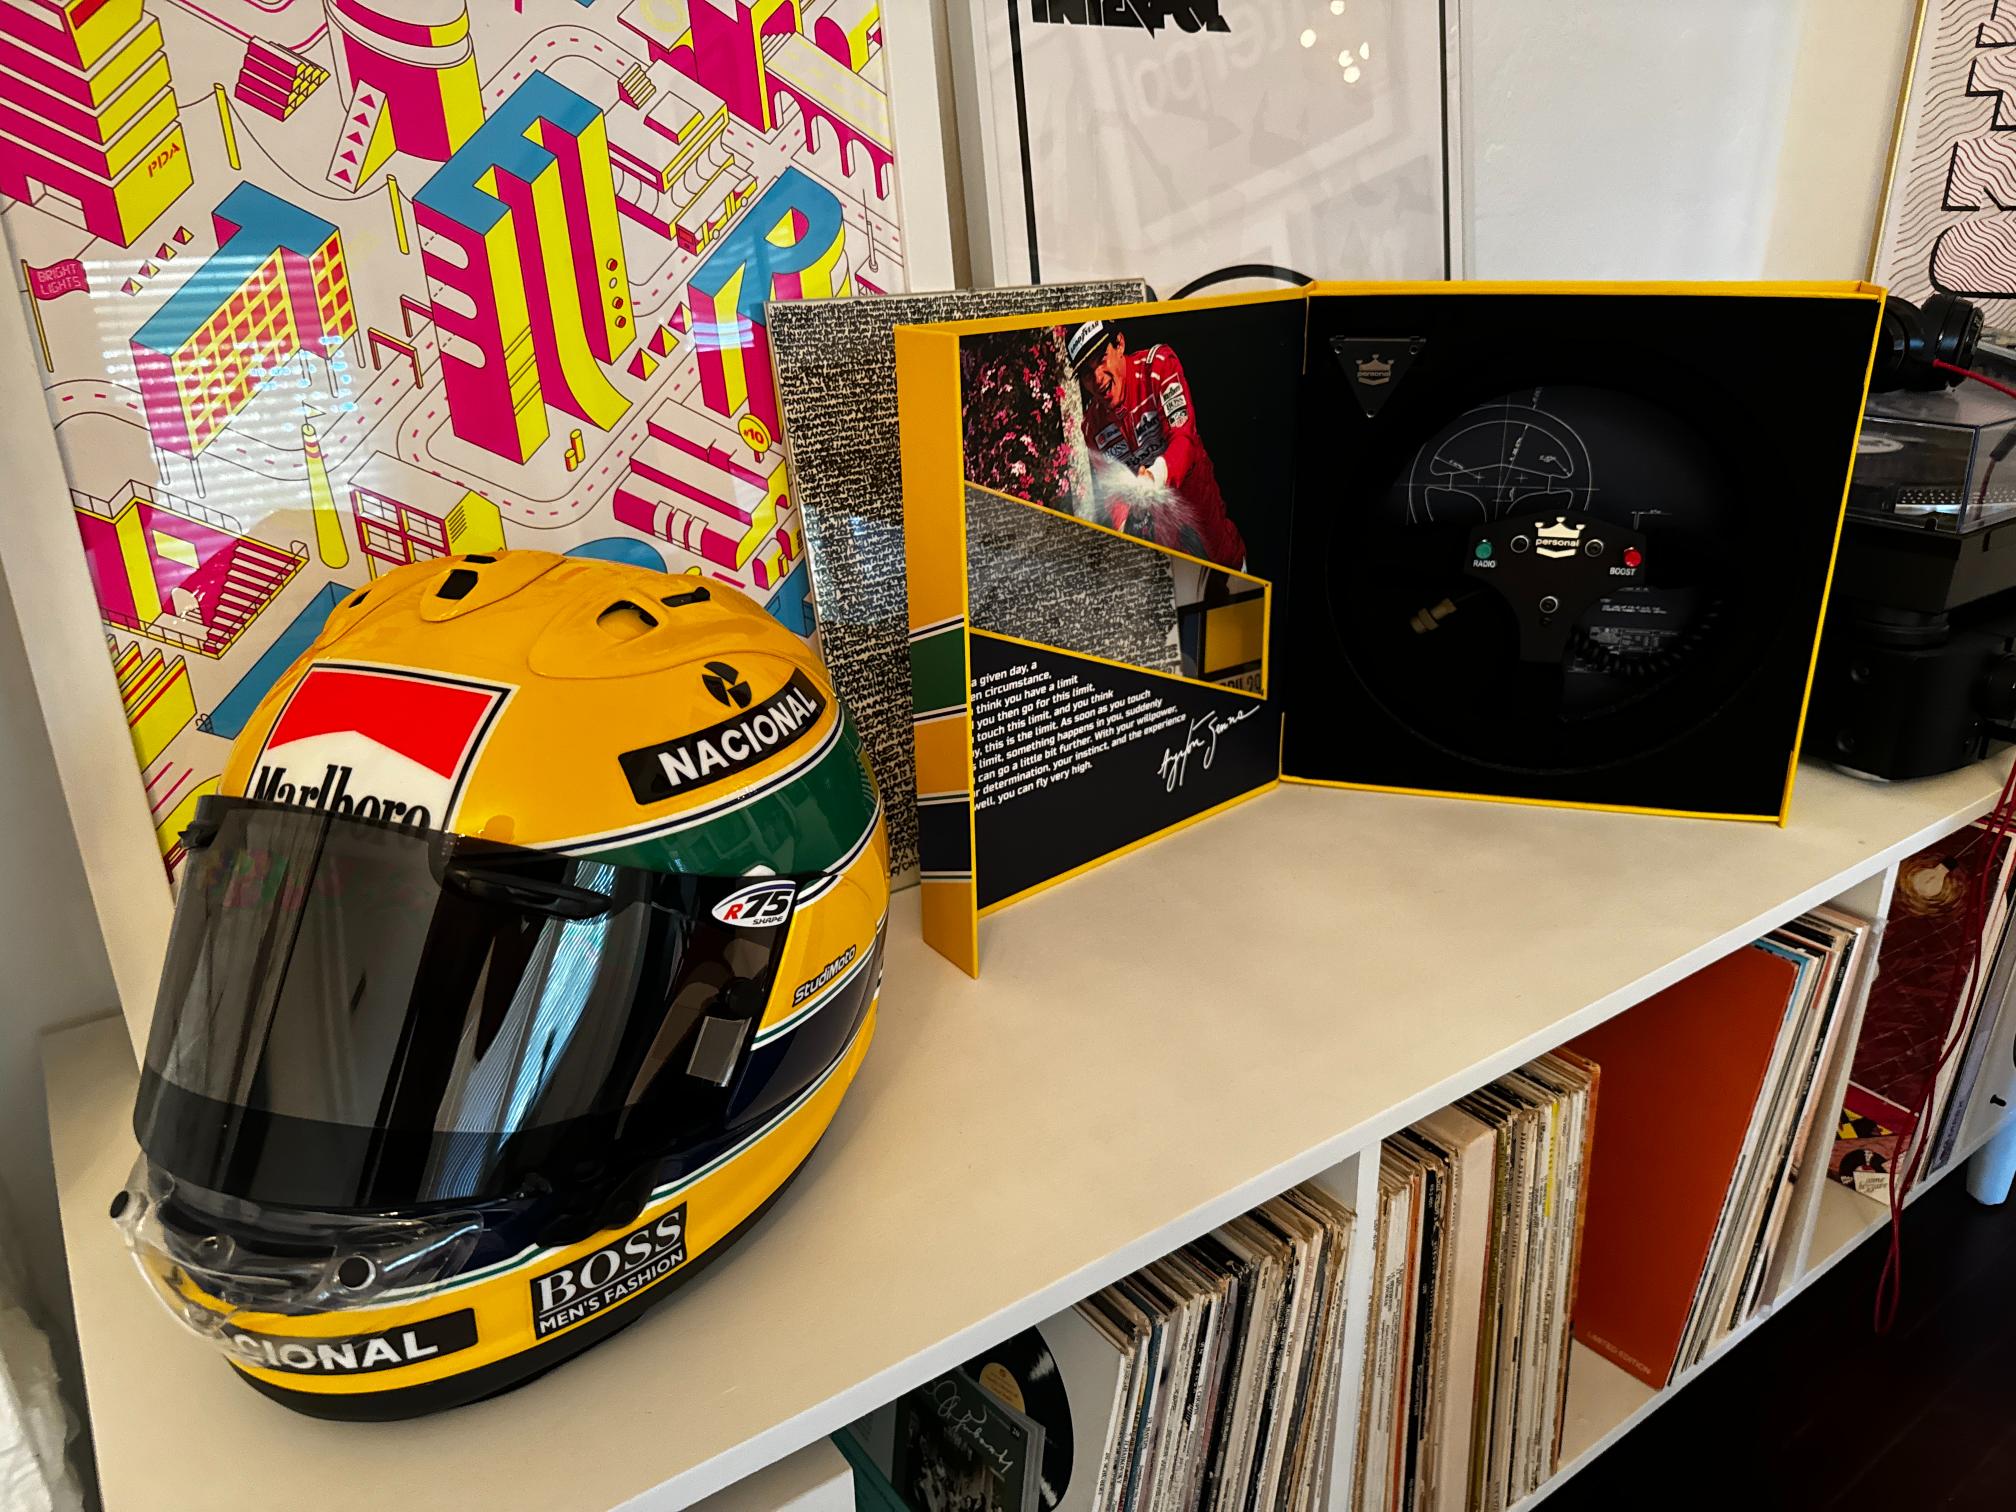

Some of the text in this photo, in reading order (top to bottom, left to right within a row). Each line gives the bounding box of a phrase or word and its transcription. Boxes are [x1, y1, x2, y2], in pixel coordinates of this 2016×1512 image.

[148, 142, 181, 178] PDA
[37, 264, 76, 283] BRIGHT
[40, 277, 81, 294] LIGHTS
[1536, 538, 1580, 548] personal
[1473, 559, 1496, 569] RADIO
[1609, 566, 1636, 577] BOOST
[980, 670, 1007, 687] given
[1031, 661, 1038, 670] a
[976, 675, 1078, 715] think you have a limit
[976, 716, 995, 730] you
[997, 708, 1020, 722] then
[1021, 703, 1034, 716] go
[1035, 697, 1051, 709] for
[1052, 691, 1070, 704] this
[977, 726, 1005, 742] touch
[1007, 720, 1026, 732] this
[1053, 704, 1071, 717] and
[1072, 699, 1089, 712] you
[1091, 689, 1114, 704] think
[984, 740, 1004, 753] this
[1006, 736, 1015, 746] is
[1017, 729, 1033, 740] the
[1060, 717, 1073, 728] As
[1074, 709, 1096, 723] soon
[1097, 704, 1108, 715] as
[1109, 699, 1126, 712] you
[1127, 689, 1151, 705] touch
[1006, 736, 1055, 759] something
[1057, 722, 1095, 742] happens
[1096, 717, 1105, 728] in
[1125, 698, 1163, 718] suddenly
[657, 687, 818, 787] NACIONAL
[978, 770, 996, 783] can
[997, 765, 1010, 778] go
[1012, 761, 1018, 771] a
[1020, 753, 1043, 768] little
[1044, 747, 1058, 759] bit
[1059, 735, 1093, 755] further.
[1094, 726, 1115, 741] With
[1115, 719, 1135, 734] your
[1052, 755, 1073, 771] your
[1111, 734, 1127, 748] and
[1128, 729, 1143, 741] the
[1143, 713, 1187, 735] experience
[253, 763, 431, 830] Marlboro
[997, 789, 1015, 804] you
[1017, 782, 1034, 795] can
[1035, 777, 1048, 788] fly
[1050, 769, 1070, 783] very
[1071, 760, 1093, 775] high.
[723, 890, 793, 921] R75
[753, 916, 784, 925] SHAPE
[793, 945, 857, 1005] StudiMoto
[537, 1212, 681, 1313] BOSS
[539, 1249, 684, 1334] MEN'S FASHION
[1618, 1350, 1651, 1374] EDITION
